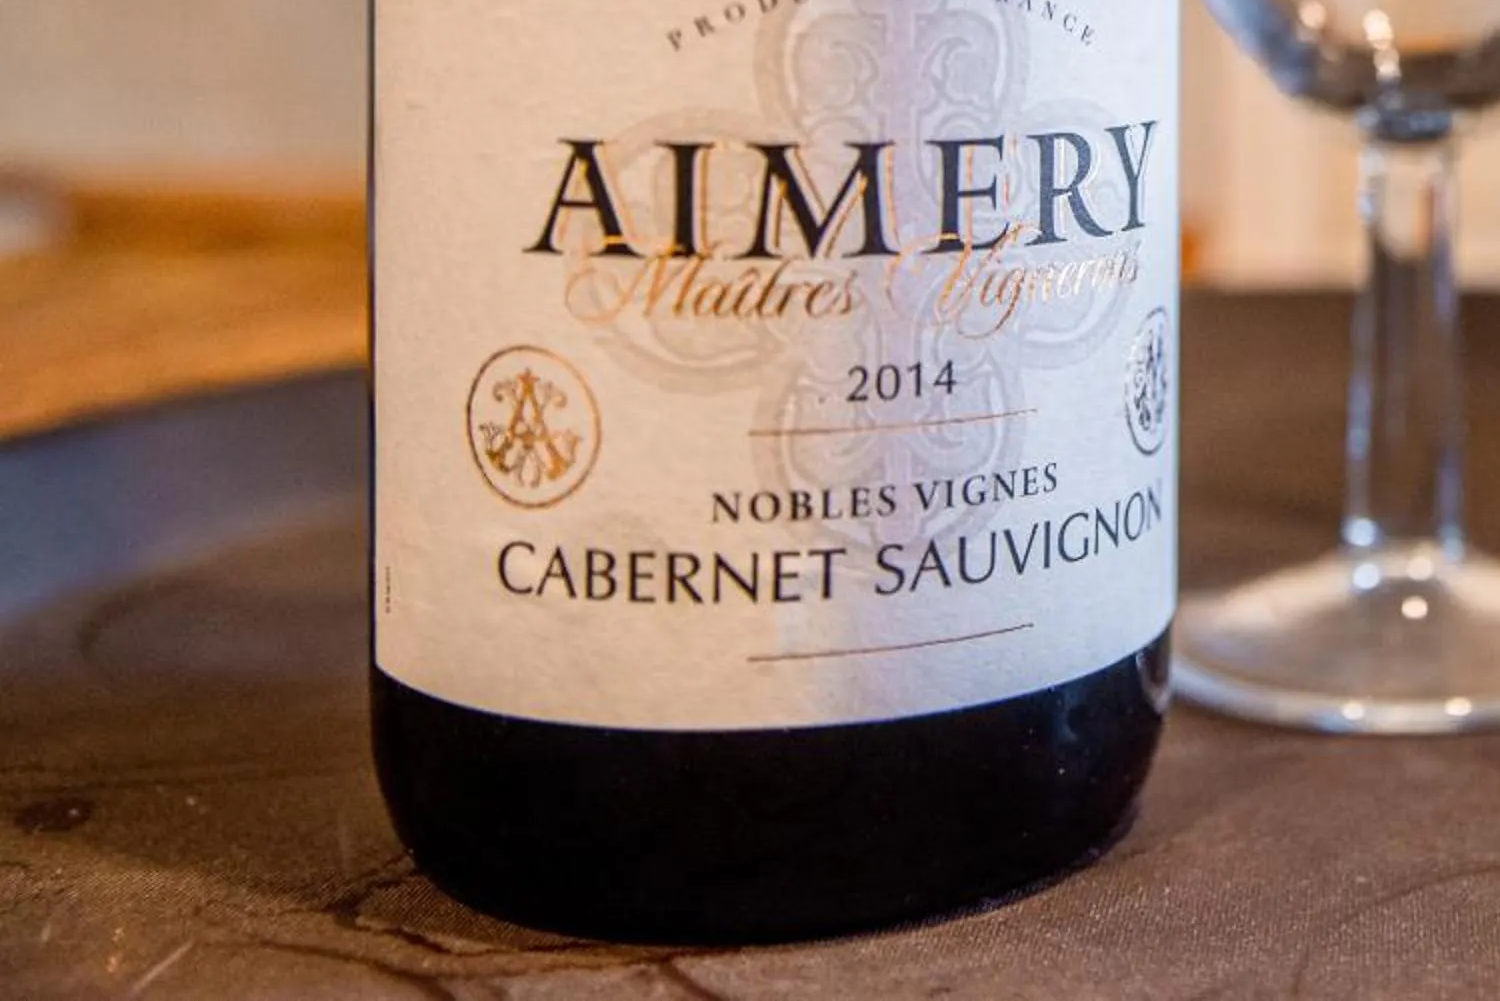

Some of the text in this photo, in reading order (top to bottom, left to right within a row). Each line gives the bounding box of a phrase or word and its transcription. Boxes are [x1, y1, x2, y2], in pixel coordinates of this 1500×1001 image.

[522, 118, 1160, 261] AIMERY
[846, 359, 957, 403] 2014
[711, 462, 1059, 523] NOBLES VIGNES
[497, 540, 847, 604] CABERNET
[872, 482, 1162, 596] SAUVIGNON
